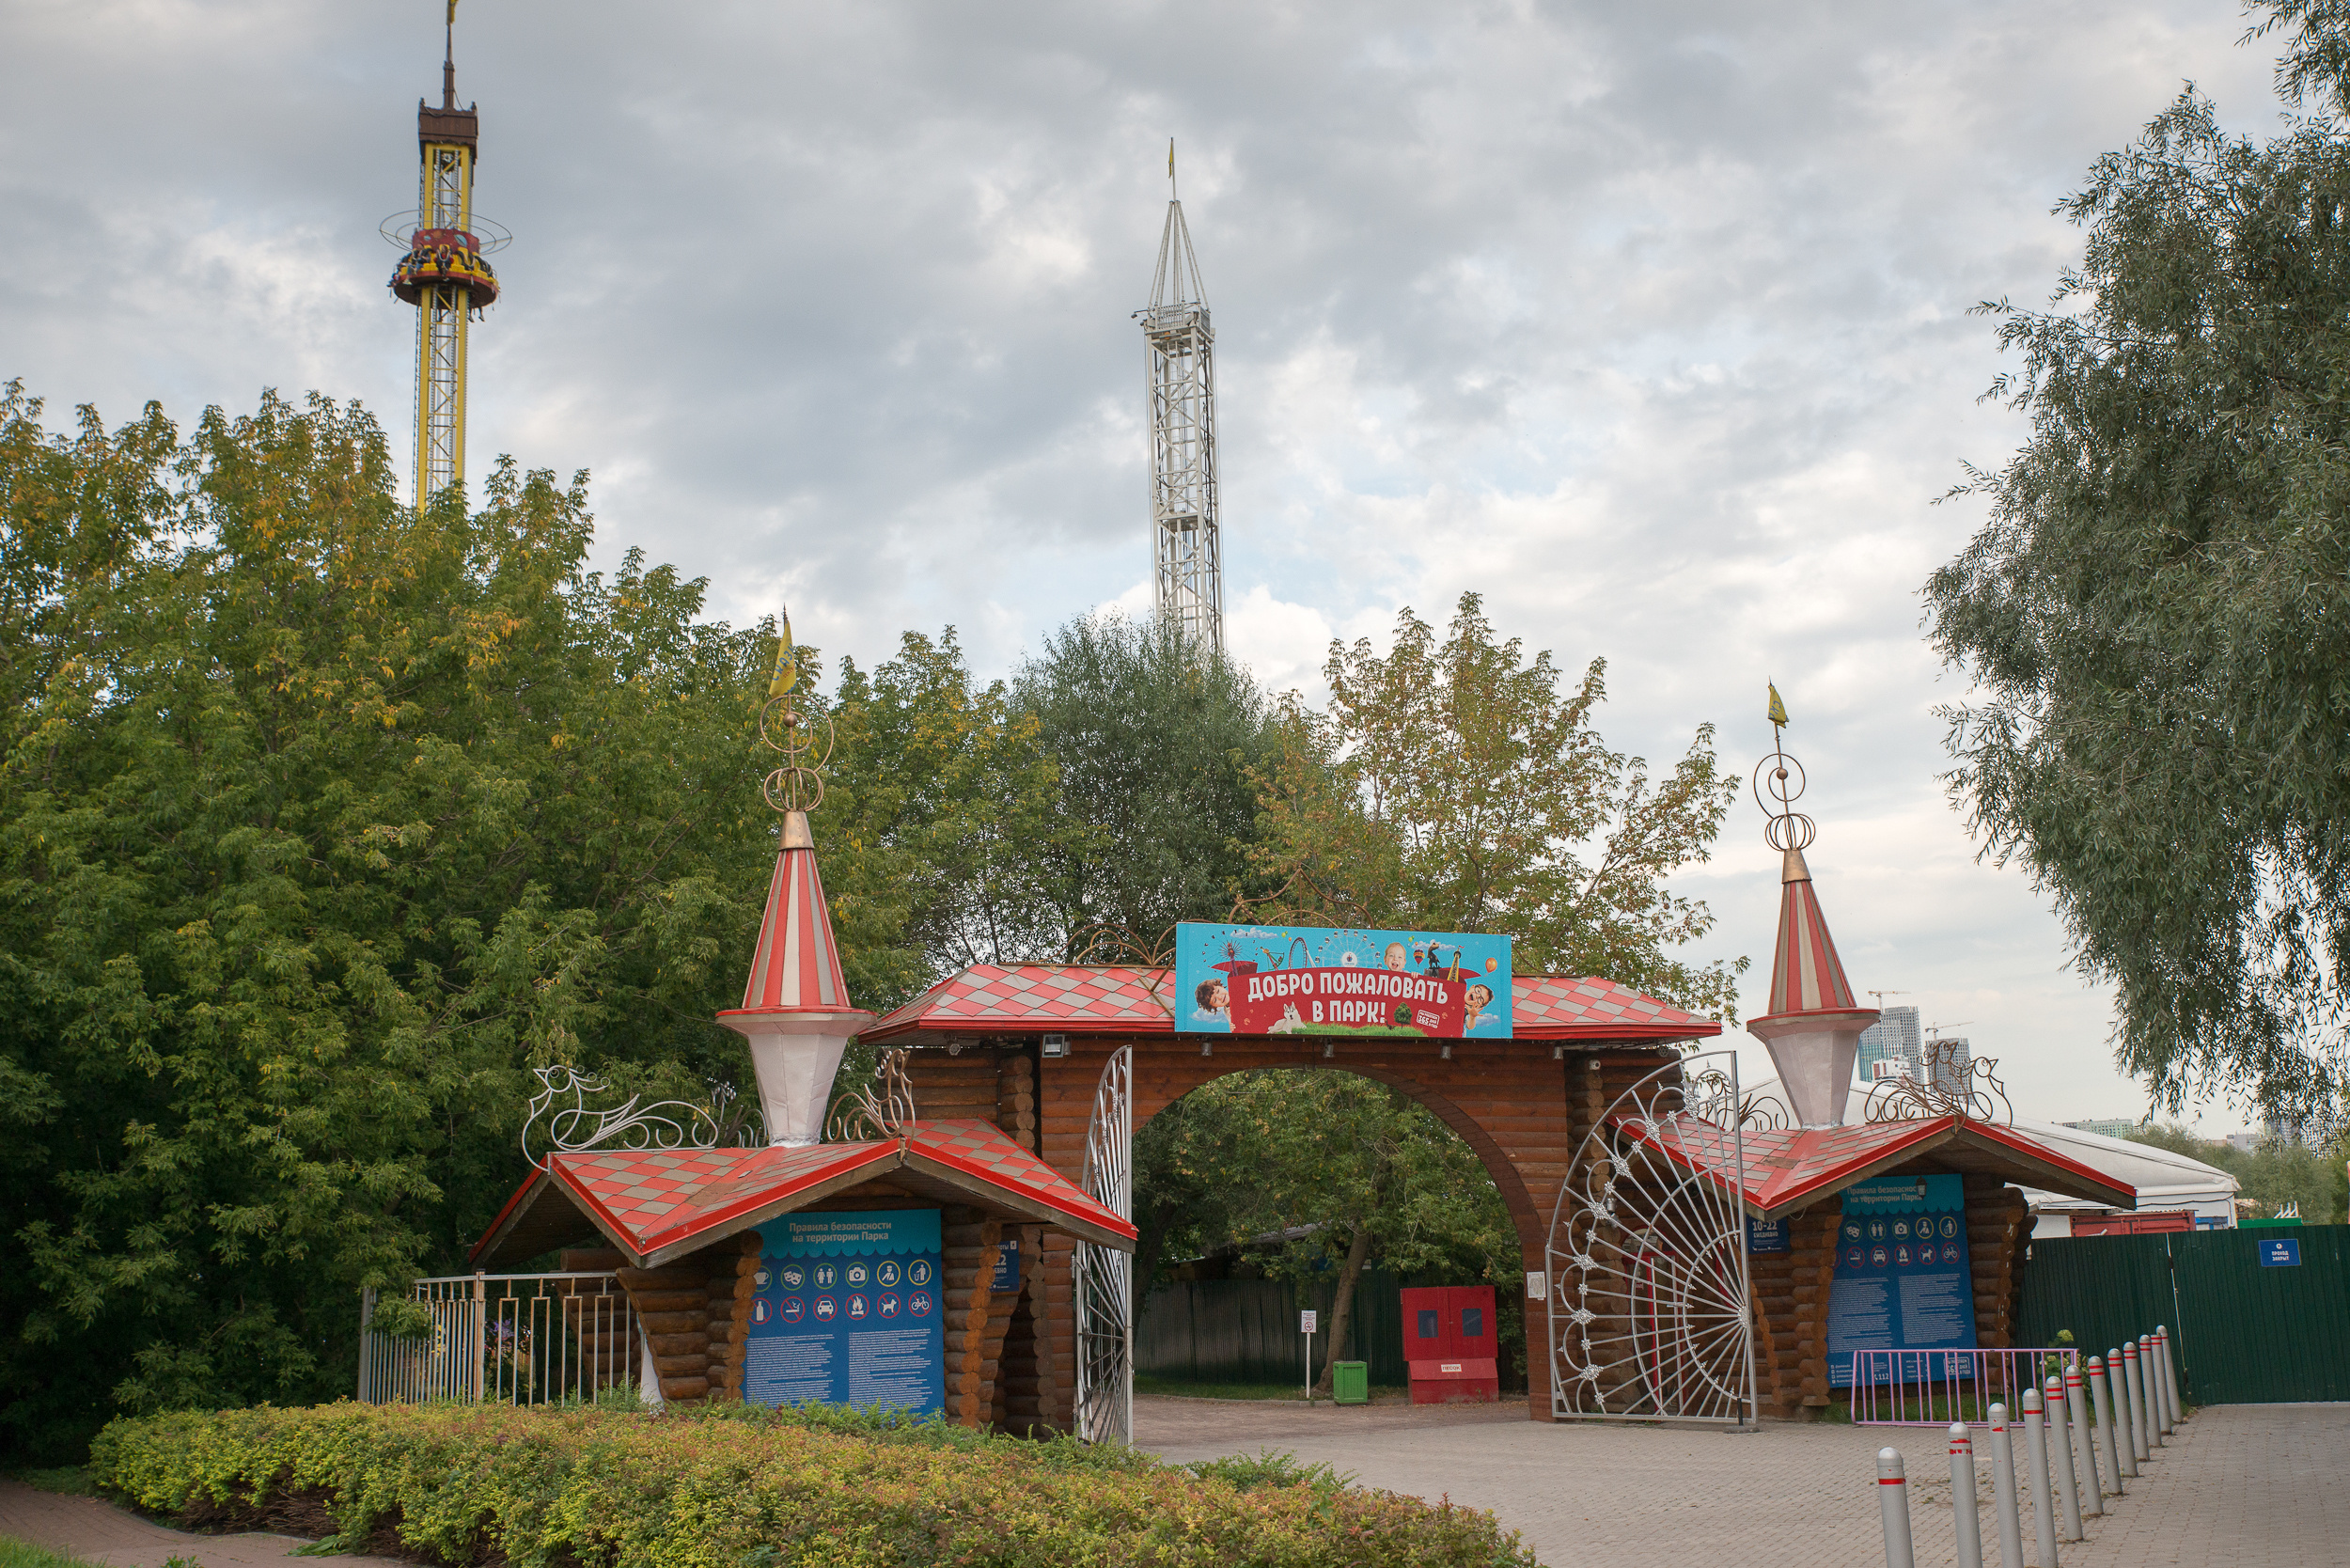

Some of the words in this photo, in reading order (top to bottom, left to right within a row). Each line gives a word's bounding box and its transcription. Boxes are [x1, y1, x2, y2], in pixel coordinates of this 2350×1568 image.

[1247, 972, 1314, 1003] ДОБРО
[1320, 972, 1449, 1005] ПОЖАЛОВАТЬ
[1312, 1000, 1324, 1023] В
[1329, 1000, 1386, 1024] ПАРК!
[1847, 1186, 1876, 1196] Правила
[1860, 1195, 1900, 1204] территории
[790, 1223, 828, 1233] Правила
[831, 1222, 892, 1231] безопасности
[806, 1233, 859, 1244] территории
[861, 1231, 888, 1242] Парка
